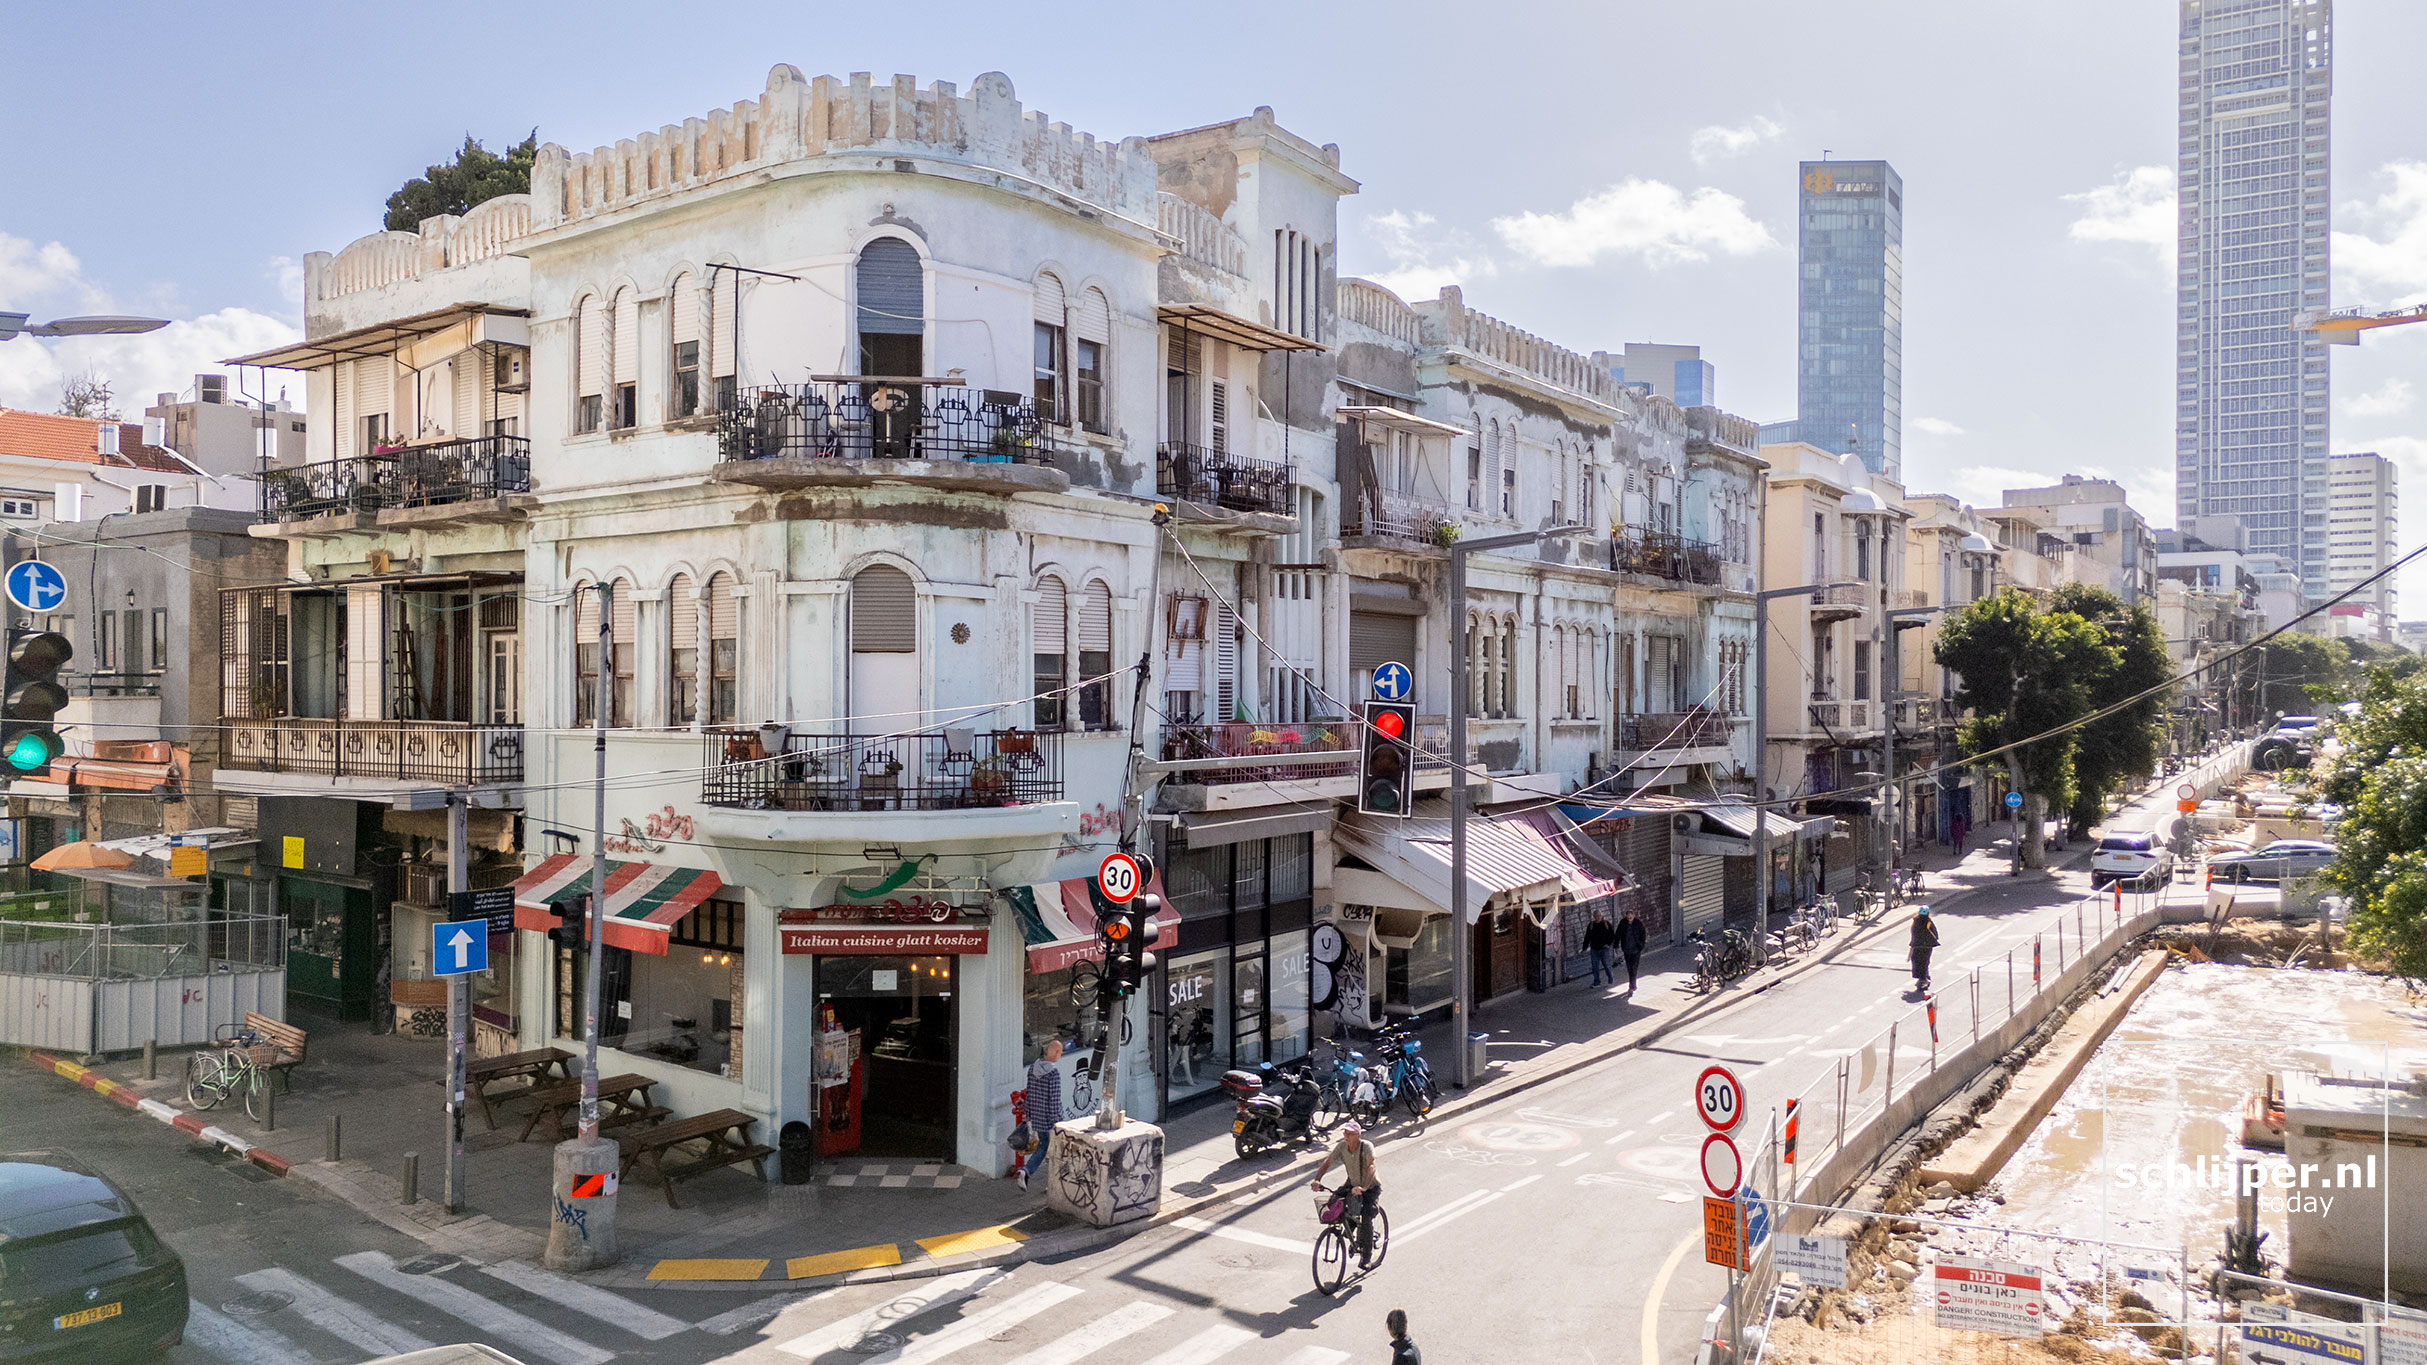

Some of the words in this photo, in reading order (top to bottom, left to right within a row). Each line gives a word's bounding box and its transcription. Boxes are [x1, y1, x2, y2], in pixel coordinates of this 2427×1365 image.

[1106, 866, 1132, 891] 30
[790, 935, 839, 948] Italian
[842, 935, 894, 947] cuisine
[896, 934, 931, 948] glatt
[934, 933, 982, 946] kosher
[1282, 952, 1310, 979] SALE
[1169, 975, 1203, 1006] SALE
[1704, 1084, 1733, 1113] 30
[1969, 1269, 2007, 1285] סכנה
[1960, 1283, 1992, 1295] בונים
[1996, 1287, 2017, 1298] כאן
[1952, 1295, 1973, 1304] מעבר
[1974, 1299, 1988, 1307] ואין
[1989, 1300, 2012, 1309] כניסה
[2012, 1303, 2024, 1311] אין
[1937, 1304, 1973, 1315] DANGER!
[1974, 1308, 2040, 1324] CONSTRUCTION!
[2248, 1321, 2273, 1339] רגל
[2275, 1329, 2320, 1350] להולכי
[2322, 1340, 2362, 1360] מעבר
